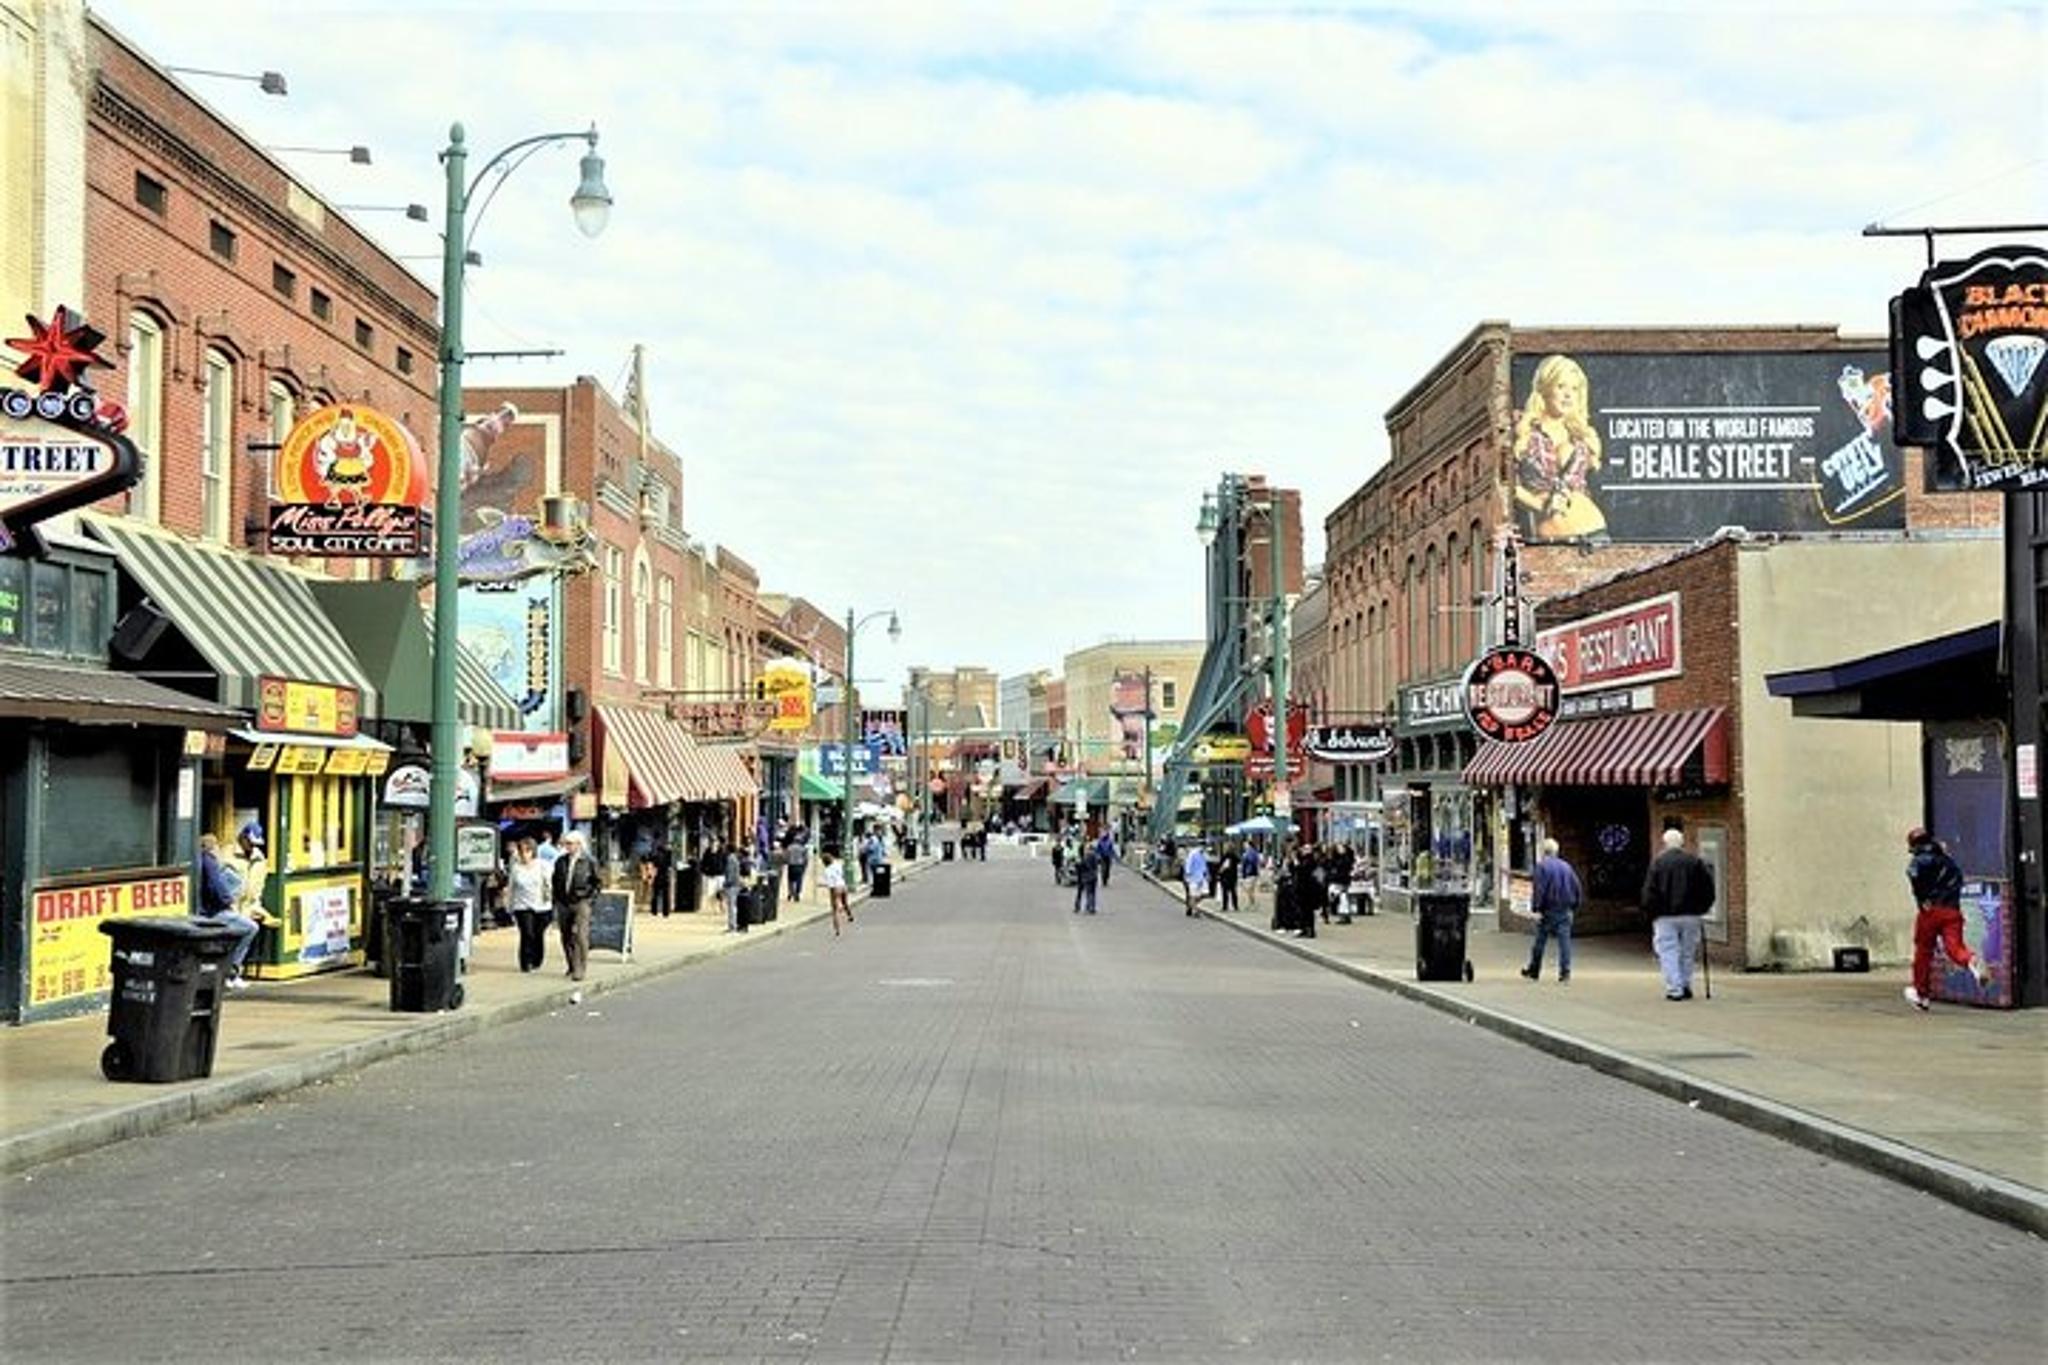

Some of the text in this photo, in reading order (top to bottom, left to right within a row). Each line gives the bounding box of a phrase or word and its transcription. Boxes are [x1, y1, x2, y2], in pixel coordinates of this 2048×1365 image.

[1965, 283, 2048, 305] BLAC
[1609, 416, 1815, 439] LOCATED ON THE WORLD FAMOUS
[2, 445, 100, 471] TREET
[1630, 443, 1793, 479] BEALE STREET
[271, 505, 337, 534] Miss
[271, 537, 321, 551] SOUL
[323, 537, 364, 551] CITY
[1579, 613, 1668, 675] RESTAURANT
[1491, 652, 1535, 673] BAR
[37, 880, 185, 923] DRAFT BEER
